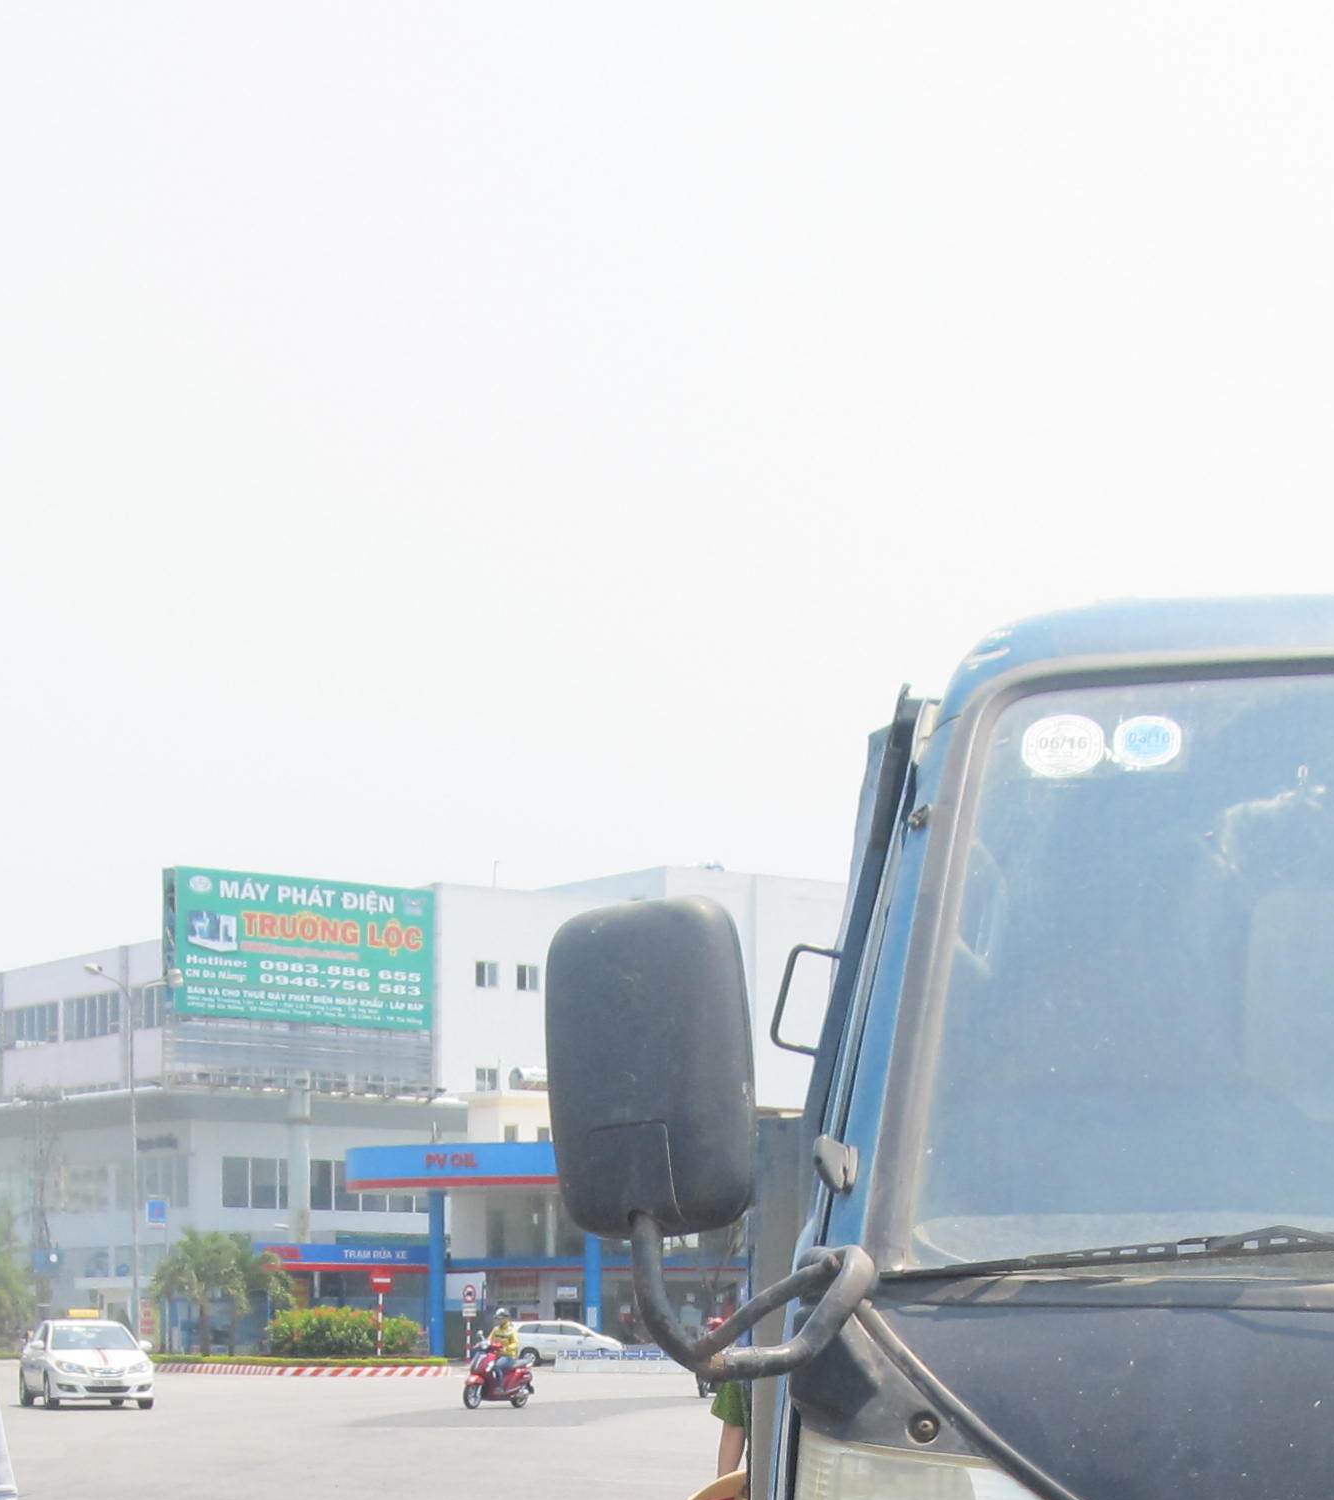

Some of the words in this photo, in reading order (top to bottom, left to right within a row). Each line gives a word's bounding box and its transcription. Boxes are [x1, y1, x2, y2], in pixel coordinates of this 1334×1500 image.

[219, 878, 270, 901] MÁY
[278, 882, 335, 907] PHÁT
[341, 890, 395, 915] ĐIỆN
[242, 910, 361, 946] TRƯỜNG
[367, 918, 424, 956] LỘC
[186, 954, 248, 968] Hotline:
[259, 959, 371, 978] 0983.886
[378, 969, 422, 983] 655
[259, 973, 371, 992] 0946.756
[378, 983, 422, 996] 583
[425, 1153, 447, 1168] PV
[452, 1152, 478, 1168] OIL
